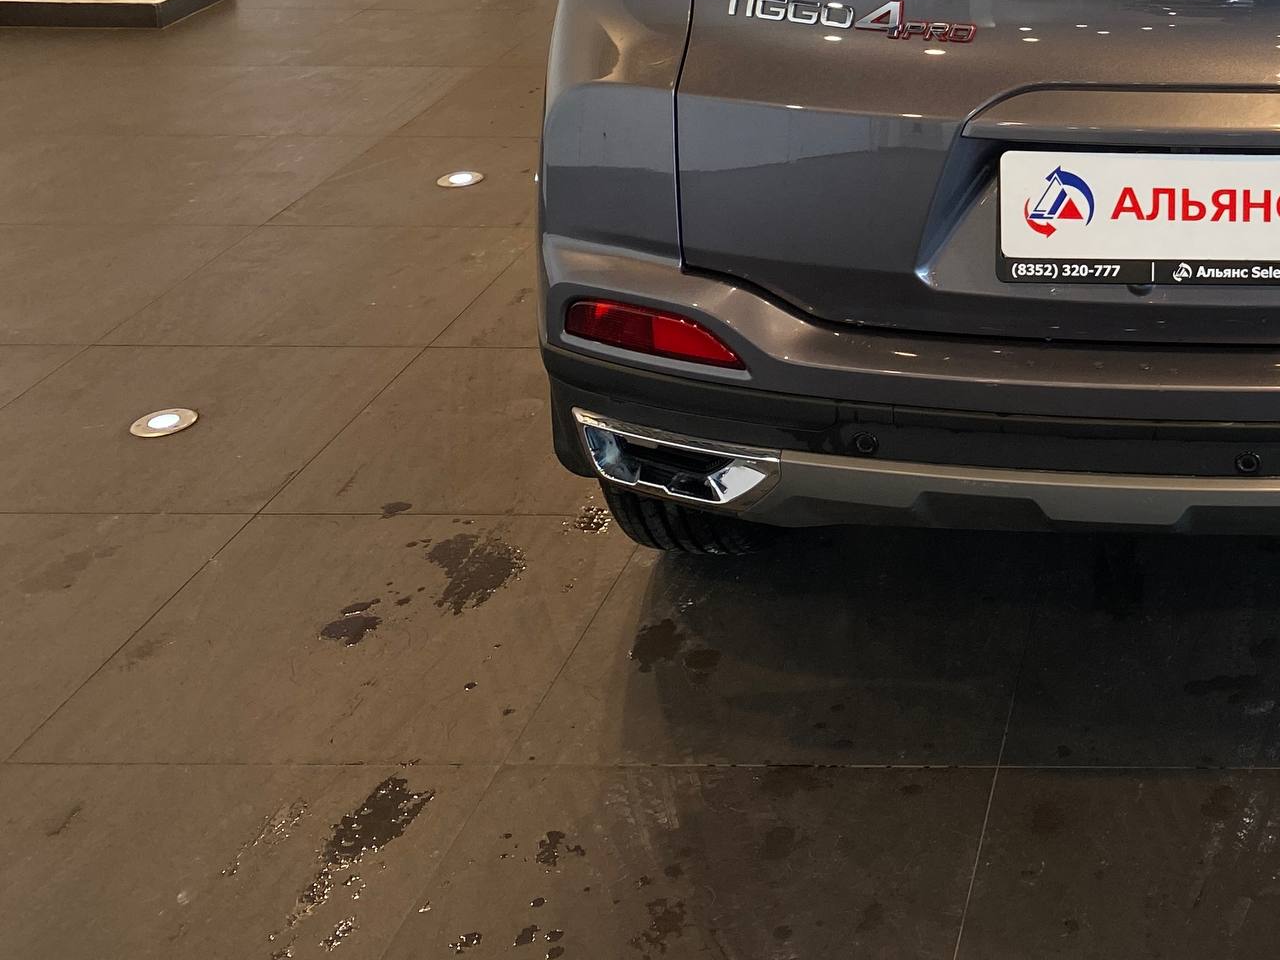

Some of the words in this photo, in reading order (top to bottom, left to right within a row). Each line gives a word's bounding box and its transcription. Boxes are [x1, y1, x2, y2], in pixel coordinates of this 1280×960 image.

[1010, 262, 1059, 279] (8352)
[1062, 264, 1121, 278] 320-777
[1196, 267, 1249, 279] Альянс
